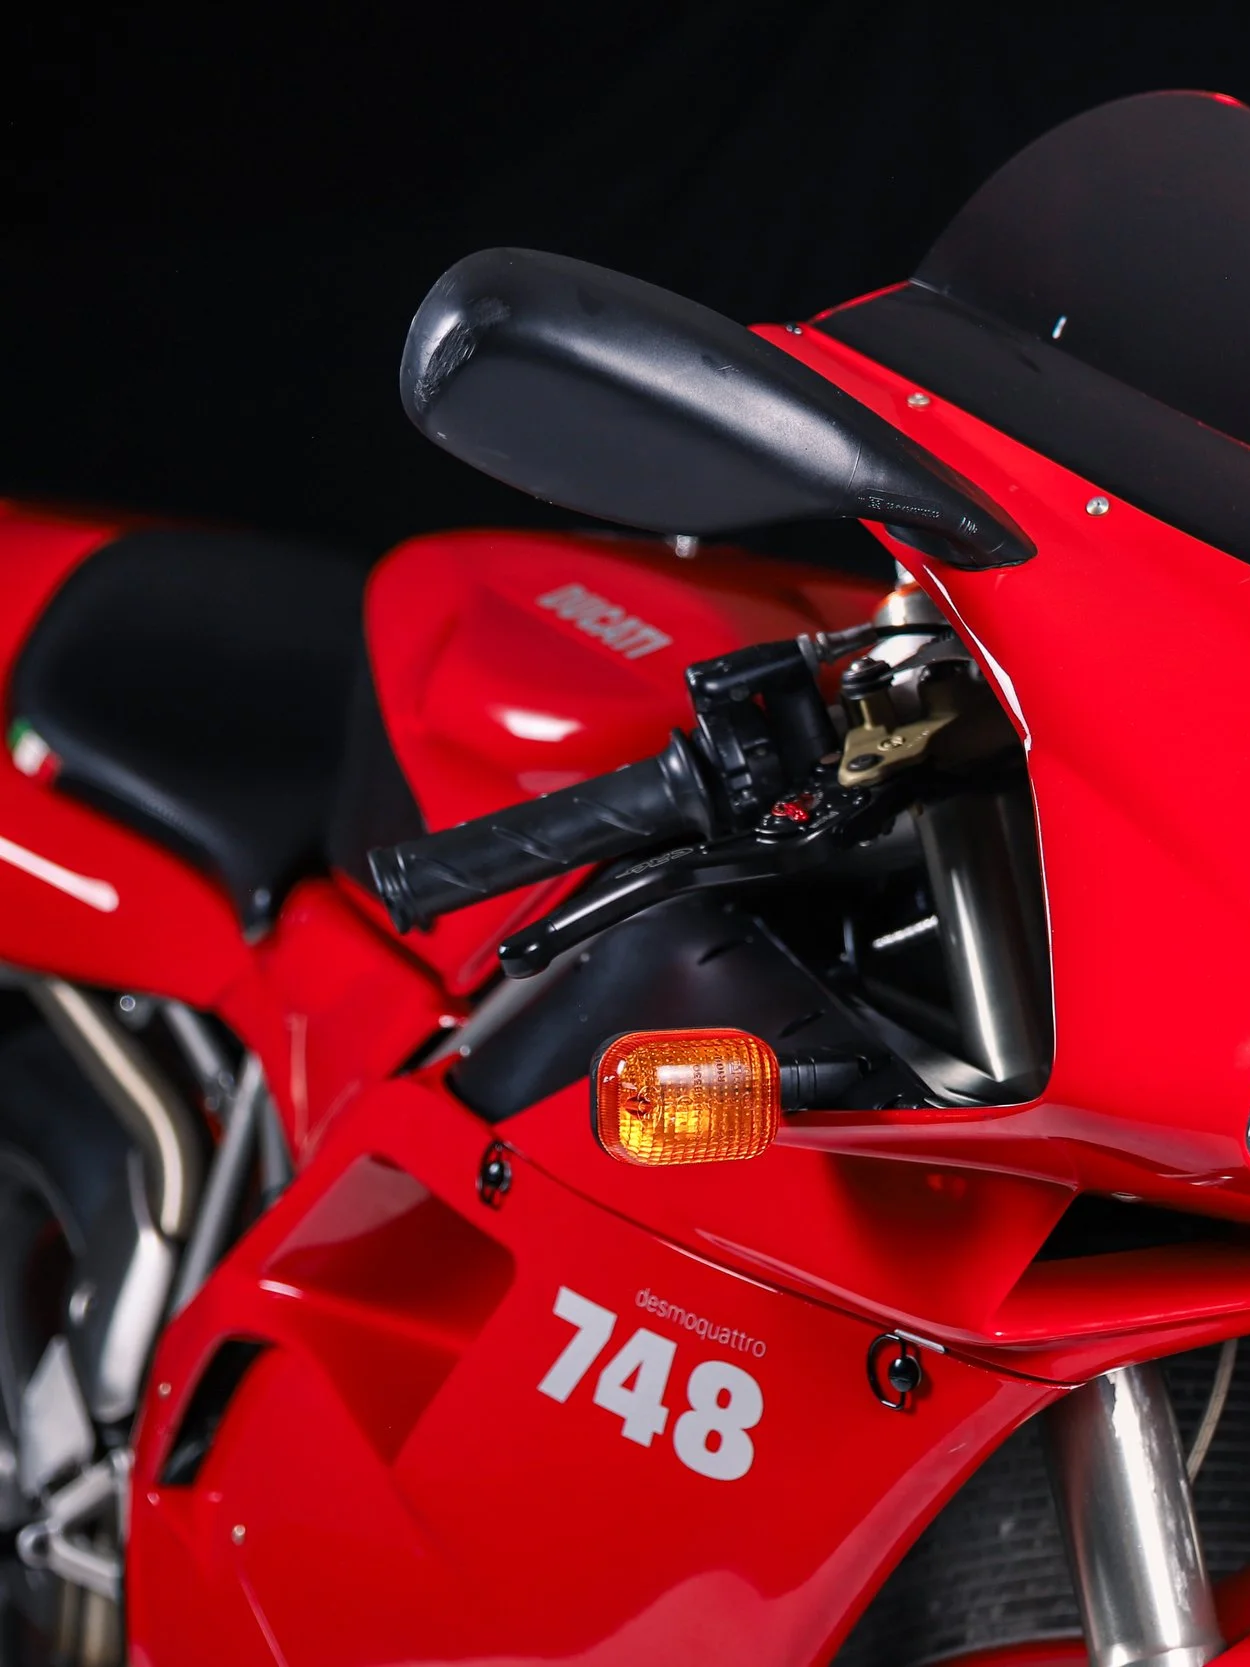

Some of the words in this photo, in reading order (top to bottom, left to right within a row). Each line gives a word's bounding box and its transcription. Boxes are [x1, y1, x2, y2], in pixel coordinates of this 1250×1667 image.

[536, 583, 673, 660] DUCATI
[634, 1288, 767, 1359] desmoquattro
[536, 1284, 764, 1481] 748
